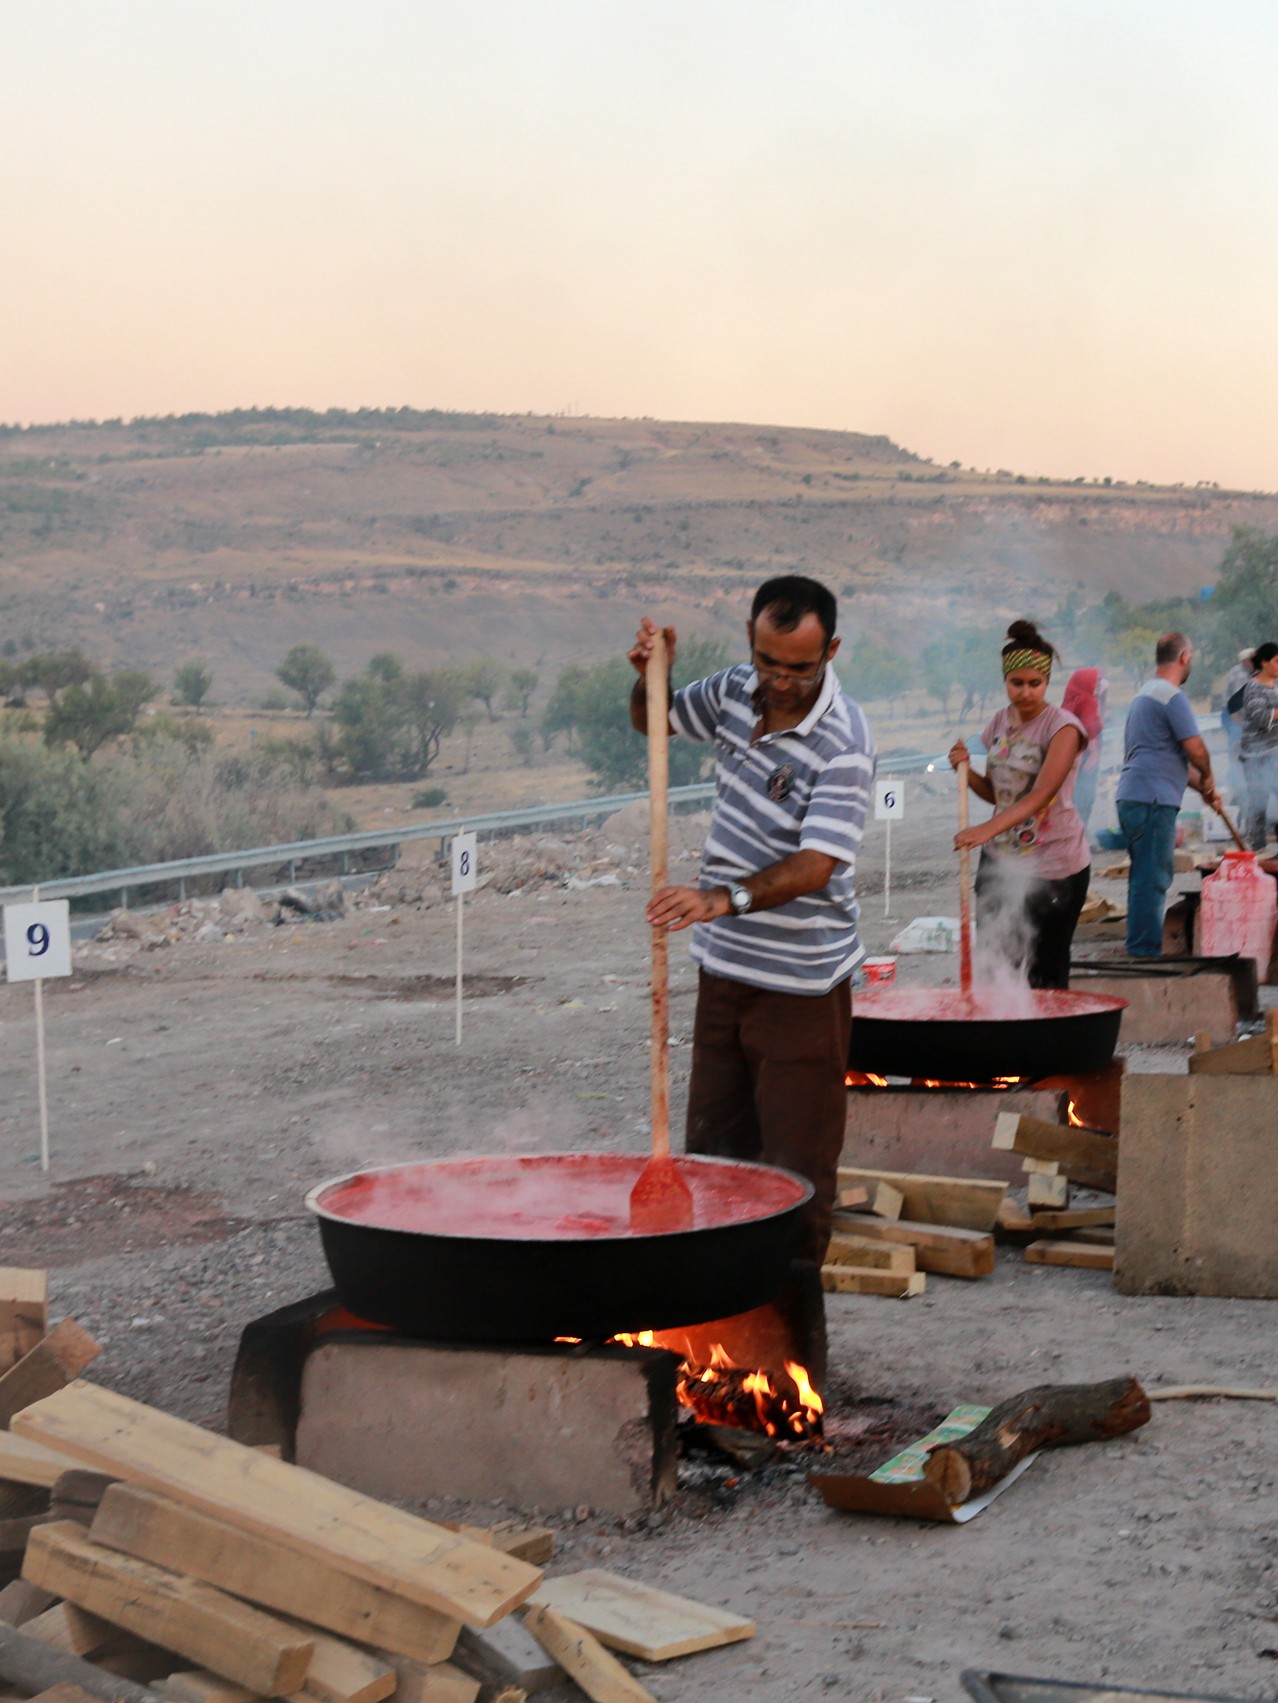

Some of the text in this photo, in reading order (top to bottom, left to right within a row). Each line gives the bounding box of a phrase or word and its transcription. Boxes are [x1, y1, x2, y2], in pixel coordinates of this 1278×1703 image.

[884, 790, 895, 809] 6
[460, 850, 470, 876] 8
[27, 923, 50, 956] 9
